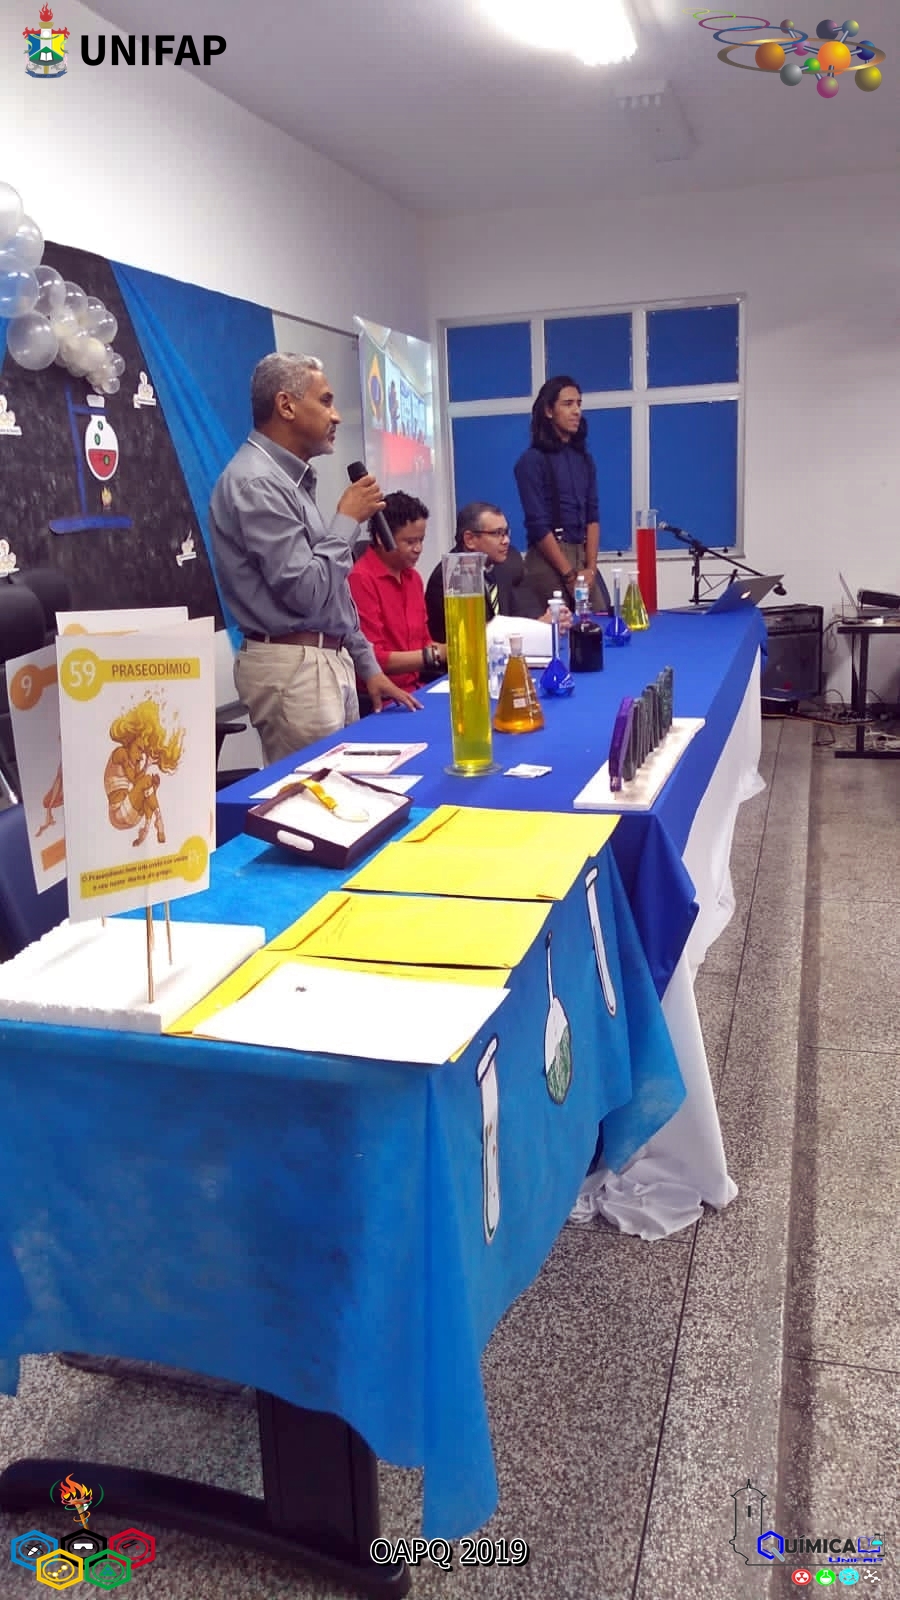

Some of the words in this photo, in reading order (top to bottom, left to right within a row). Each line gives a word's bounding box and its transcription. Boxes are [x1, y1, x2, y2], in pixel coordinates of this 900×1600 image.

[20, 674, 33, 697] 9
[69, 659, 97, 687] 59
[111, 660, 191, 677] PRASEODÍMIO
